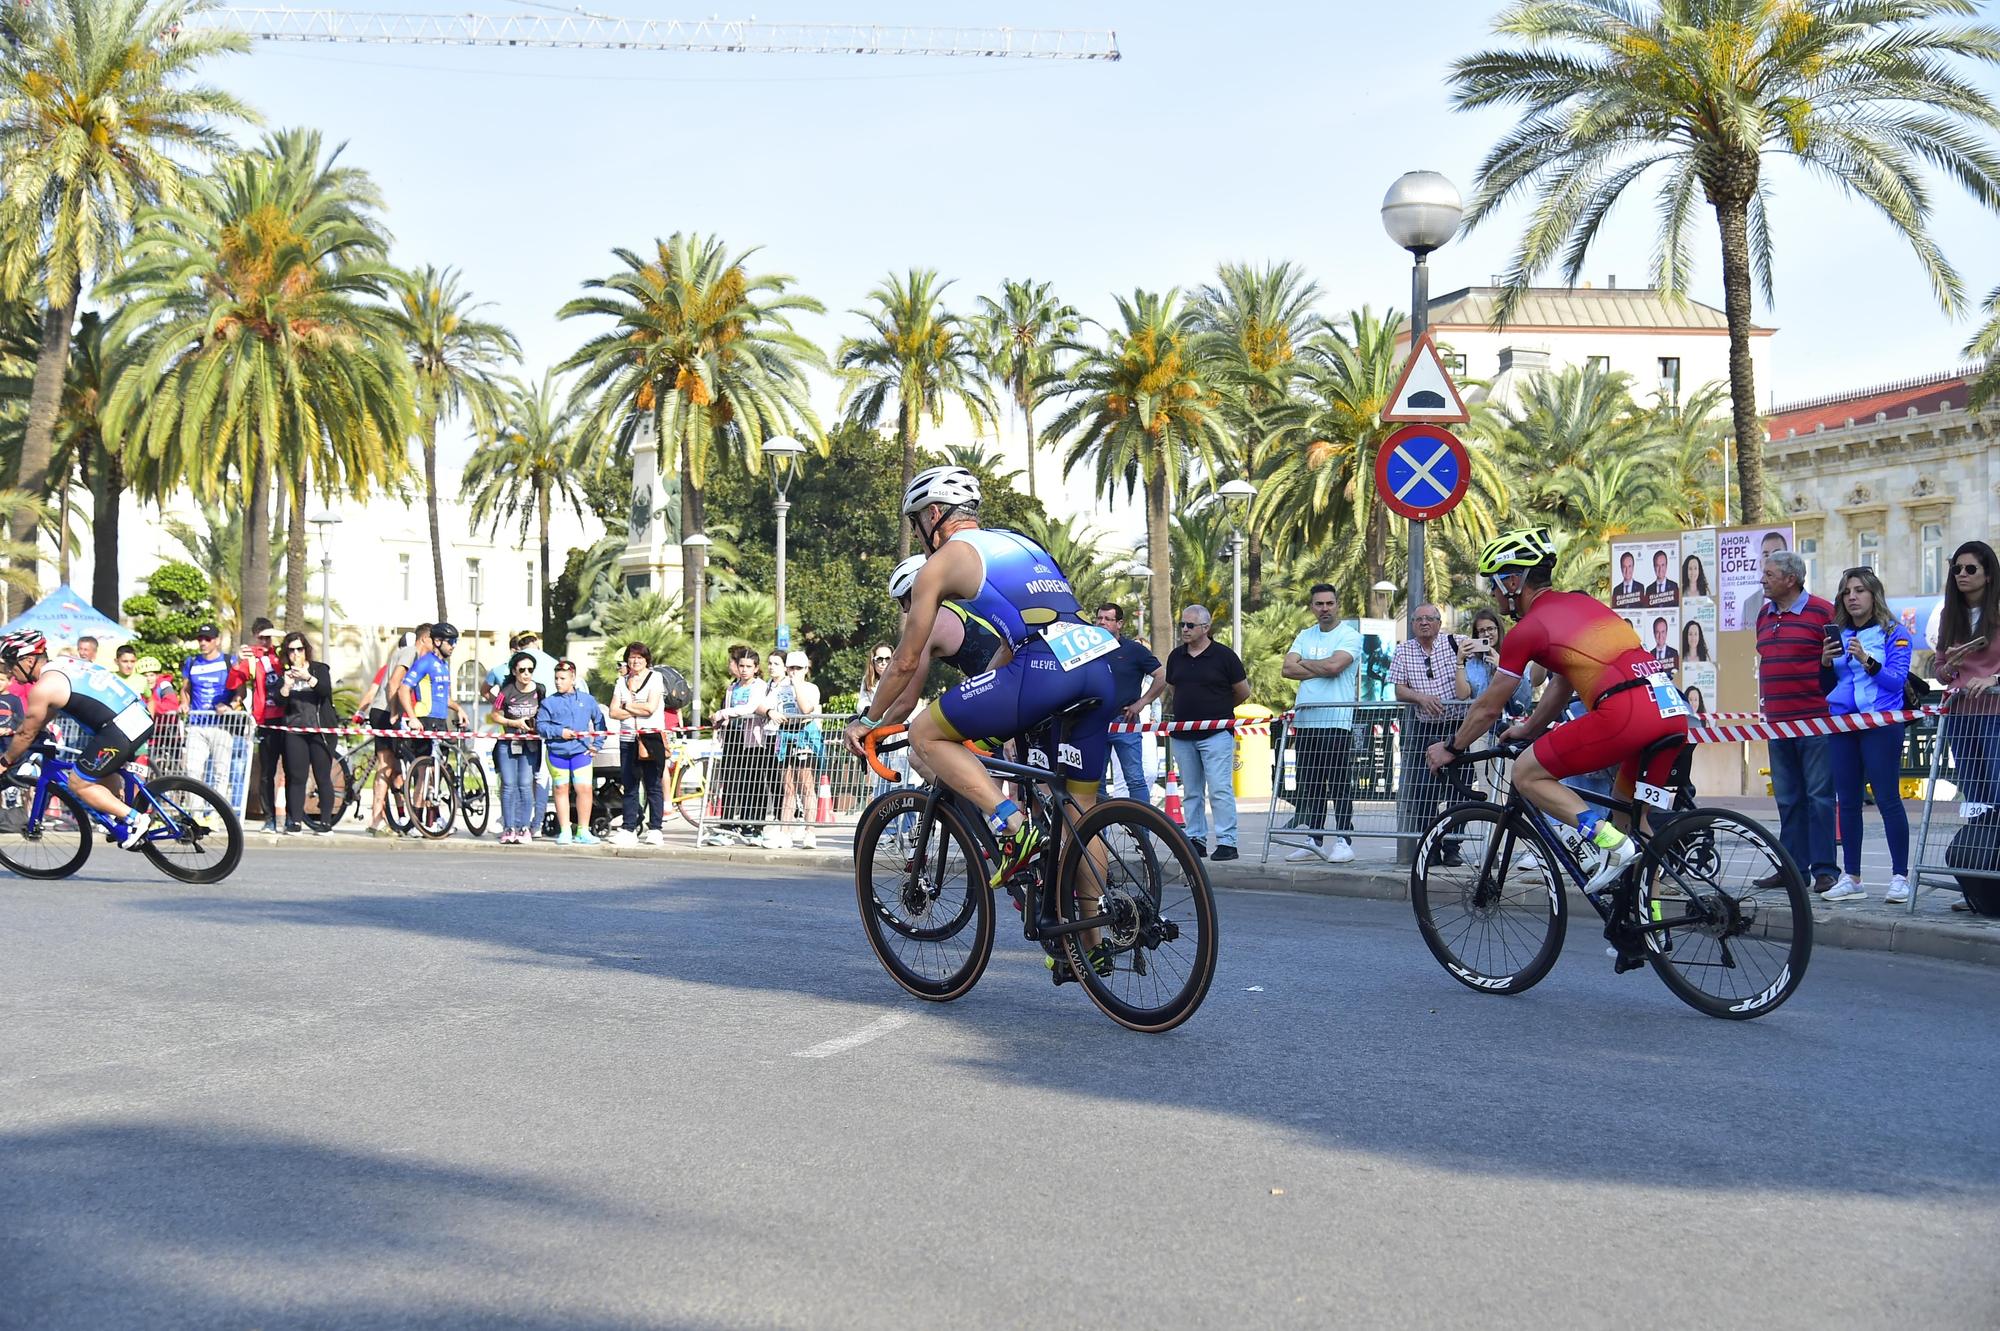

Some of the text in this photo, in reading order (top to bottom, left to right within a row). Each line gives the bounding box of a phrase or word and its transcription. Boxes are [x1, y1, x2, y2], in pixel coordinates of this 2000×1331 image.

[1721, 535, 1750, 546] AHORA
[1721, 546, 1747, 560] PEPE
[1721, 559, 1757, 573] LOPEZ
[1724, 601, 1735, 610] MC
[1724, 618, 1735, 627] MC
[1060, 626, 1103, 657] 168
[1030, 659, 1058, 671] ULEVEL
[1064, 749, 1081, 766] 168
[1645, 787, 1660, 803] 93
[878, 797, 915, 820] DT SWISS
[1710, 818, 1782, 867] ZIPP
[1068, 942, 1089, 980] SWISS
[1448, 962, 1513, 989] ZIPP
[1728, 963, 1791, 1012] ZIPP
